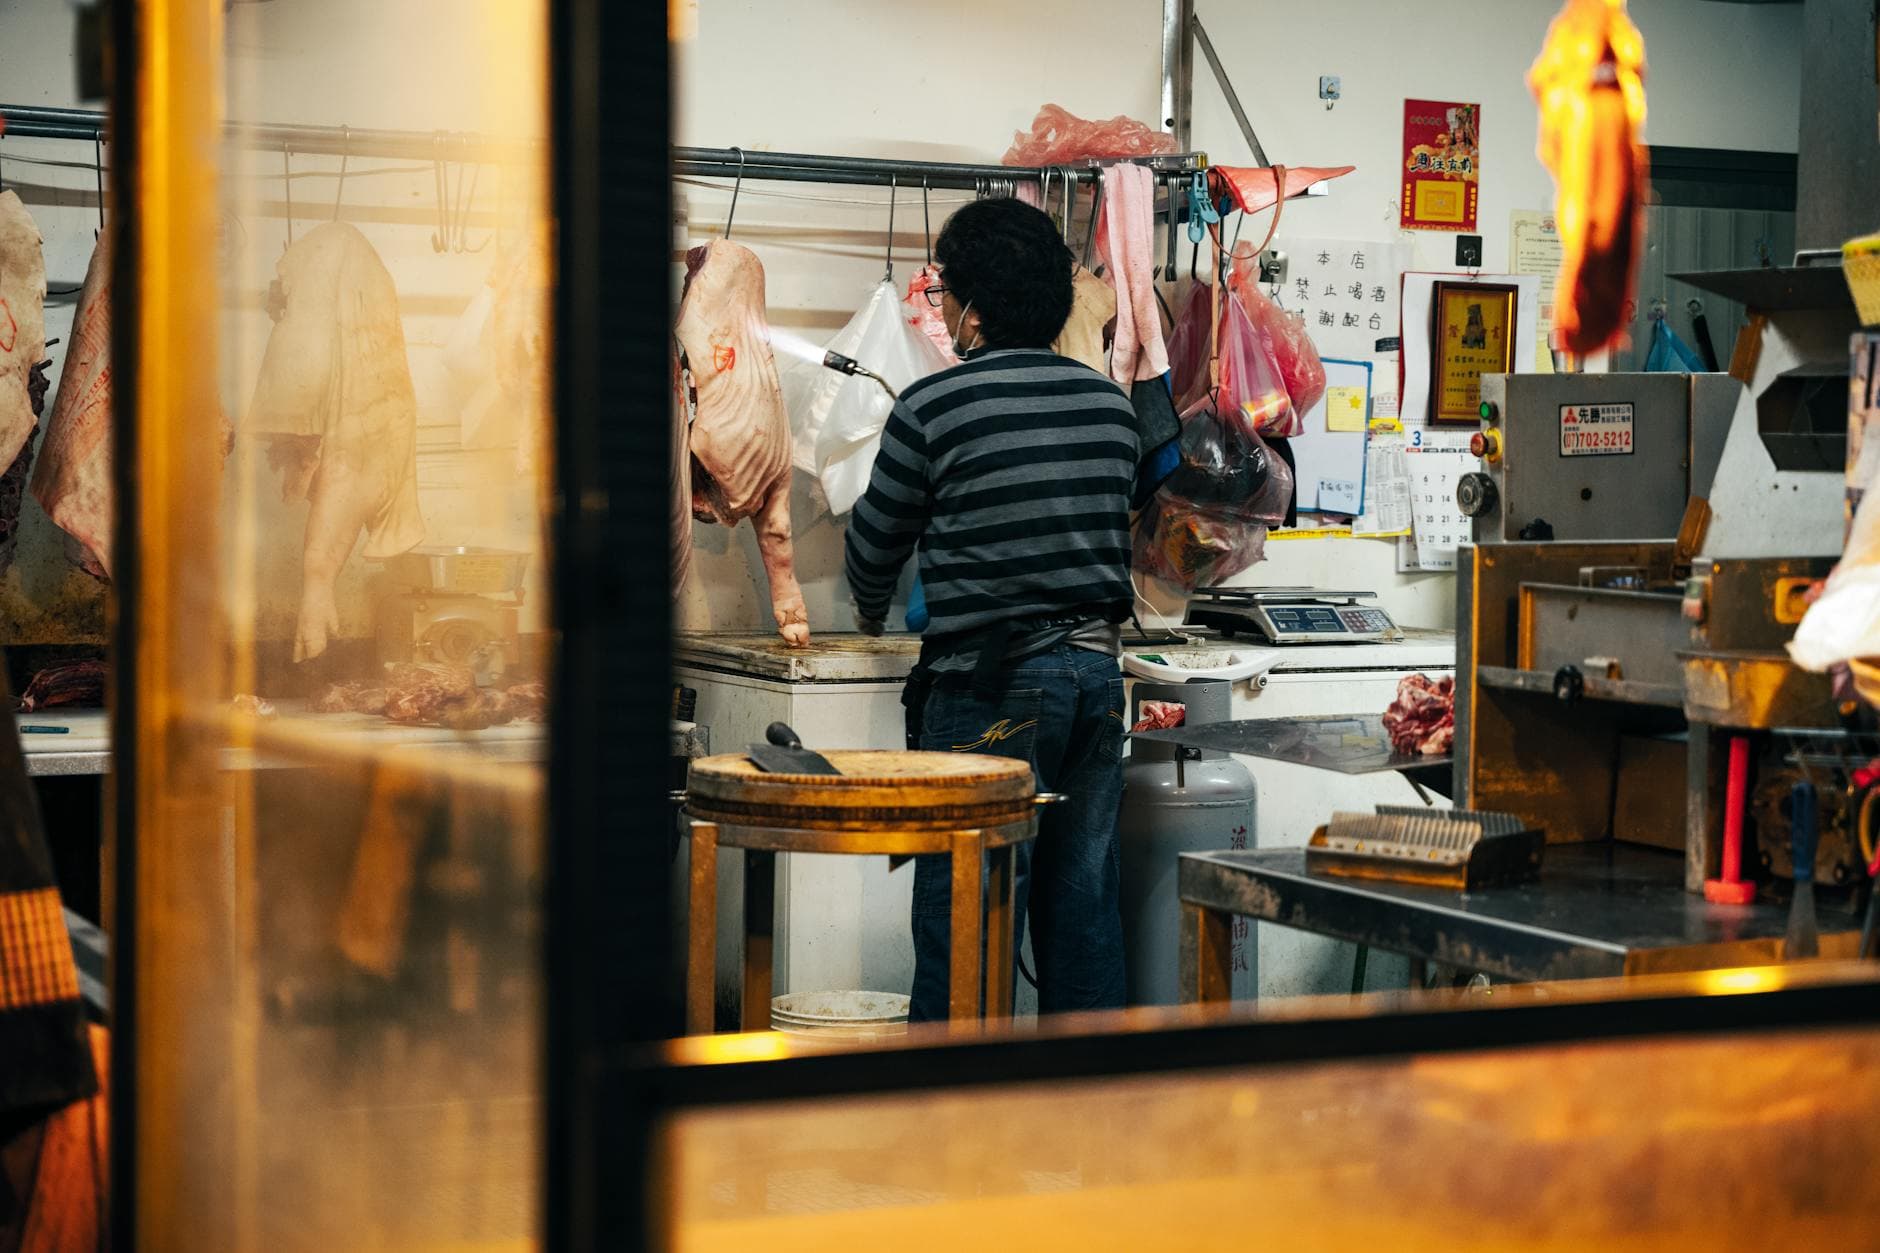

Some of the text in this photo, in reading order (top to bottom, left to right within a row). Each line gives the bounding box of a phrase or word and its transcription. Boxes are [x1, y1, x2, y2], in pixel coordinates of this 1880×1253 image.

[1317, 248, 1365, 270] 本店
[1295, 277, 1386, 303] 禁止喝酒
[1412, 430, 1422, 446] 3
[1563, 431, 1631, 448] (07)702-5212
[1424, 495, 1433, 503] 13
[1441, 495, 1451, 503] 14
[1426, 515, 1434, 523] 20
[1441, 515, 1450, 523] 21
[1458, 515, 1468, 523] 22
[1428, 535, 1435, 543] 27
[1441, 535, 1451, 543] 28
[1458, 535, 1469, 543] 29
